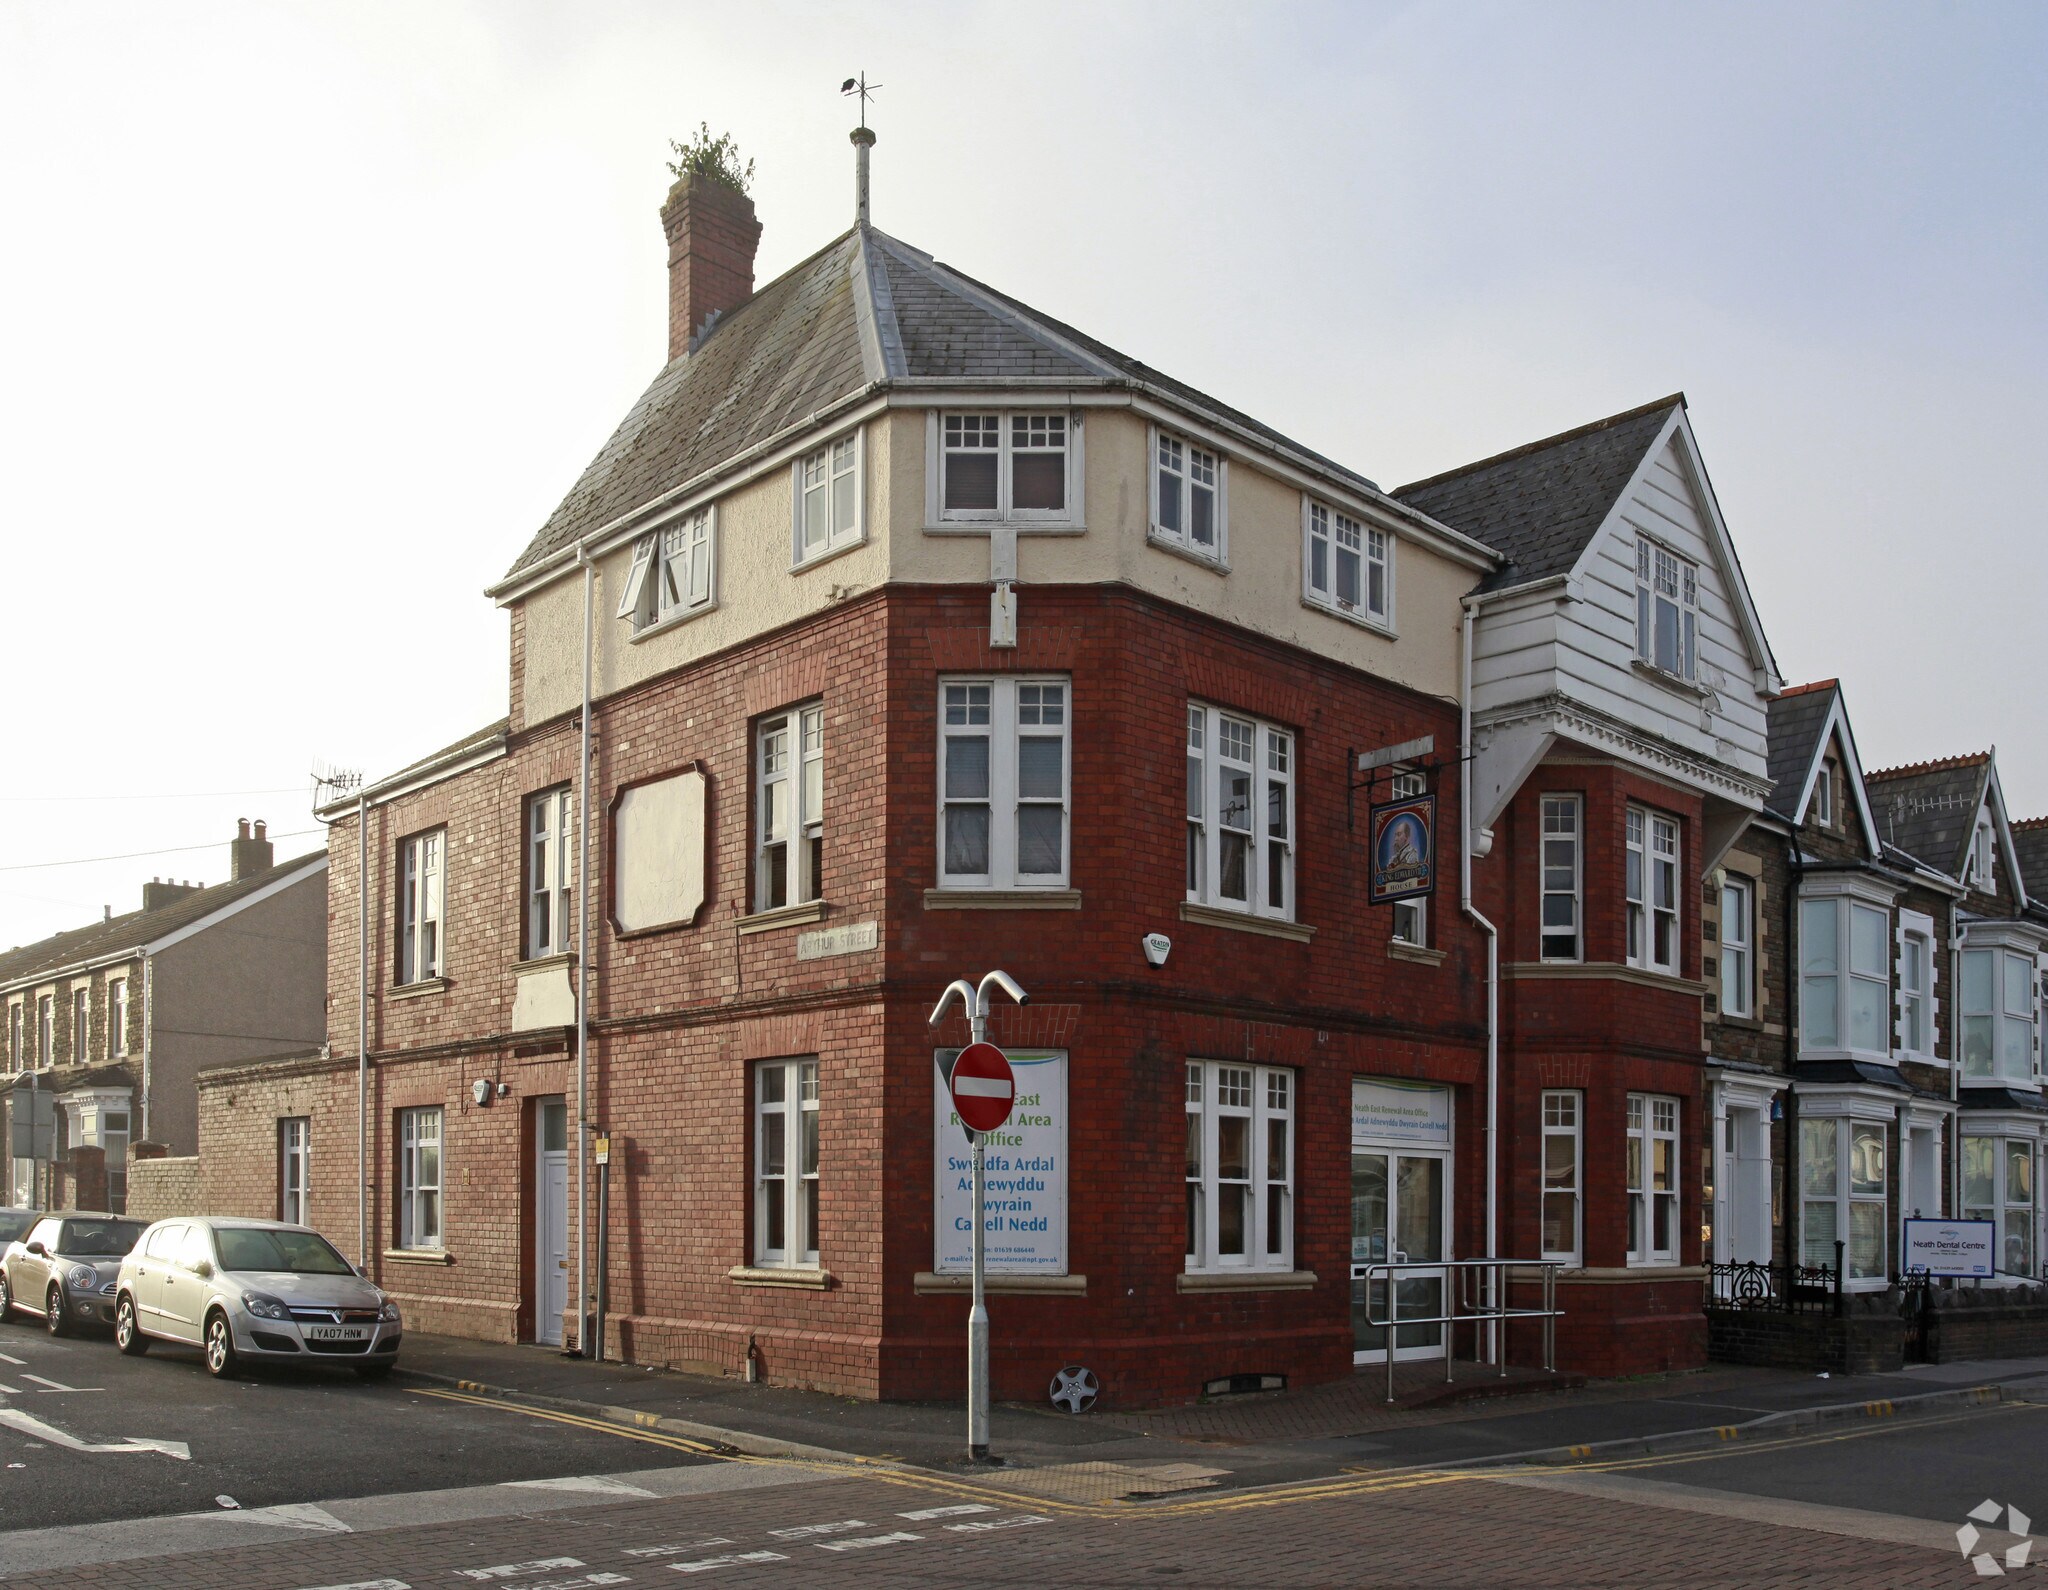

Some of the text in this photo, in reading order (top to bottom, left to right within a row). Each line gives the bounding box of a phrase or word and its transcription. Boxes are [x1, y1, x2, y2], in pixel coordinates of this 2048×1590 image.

[1391, 882, 1412, 891] HOUSE
[840, 930, 873, 947] STREET
[1354, 1104, 1428, 1117] Neath East Renewal Area Office
[1018, 1113, 1052, 1126] Area
[983, 1132, 1023, 1147] Office
[948, 1157, 1010, 1173] Swydfa
[1014, 1156, 1054, 1171] Ardal
[957, 1176, 1045, 1194] Aewyddu
[971, 1197, 1032, 1214] wyrain
[954, 1217, 1048, 1231] Caell Nedd
[1913, 1240, 1935, 1248] Neath
[1936, 1240, 1960, 1248] Dental
[317, 1328, 362, 1338] YA07 HNW
